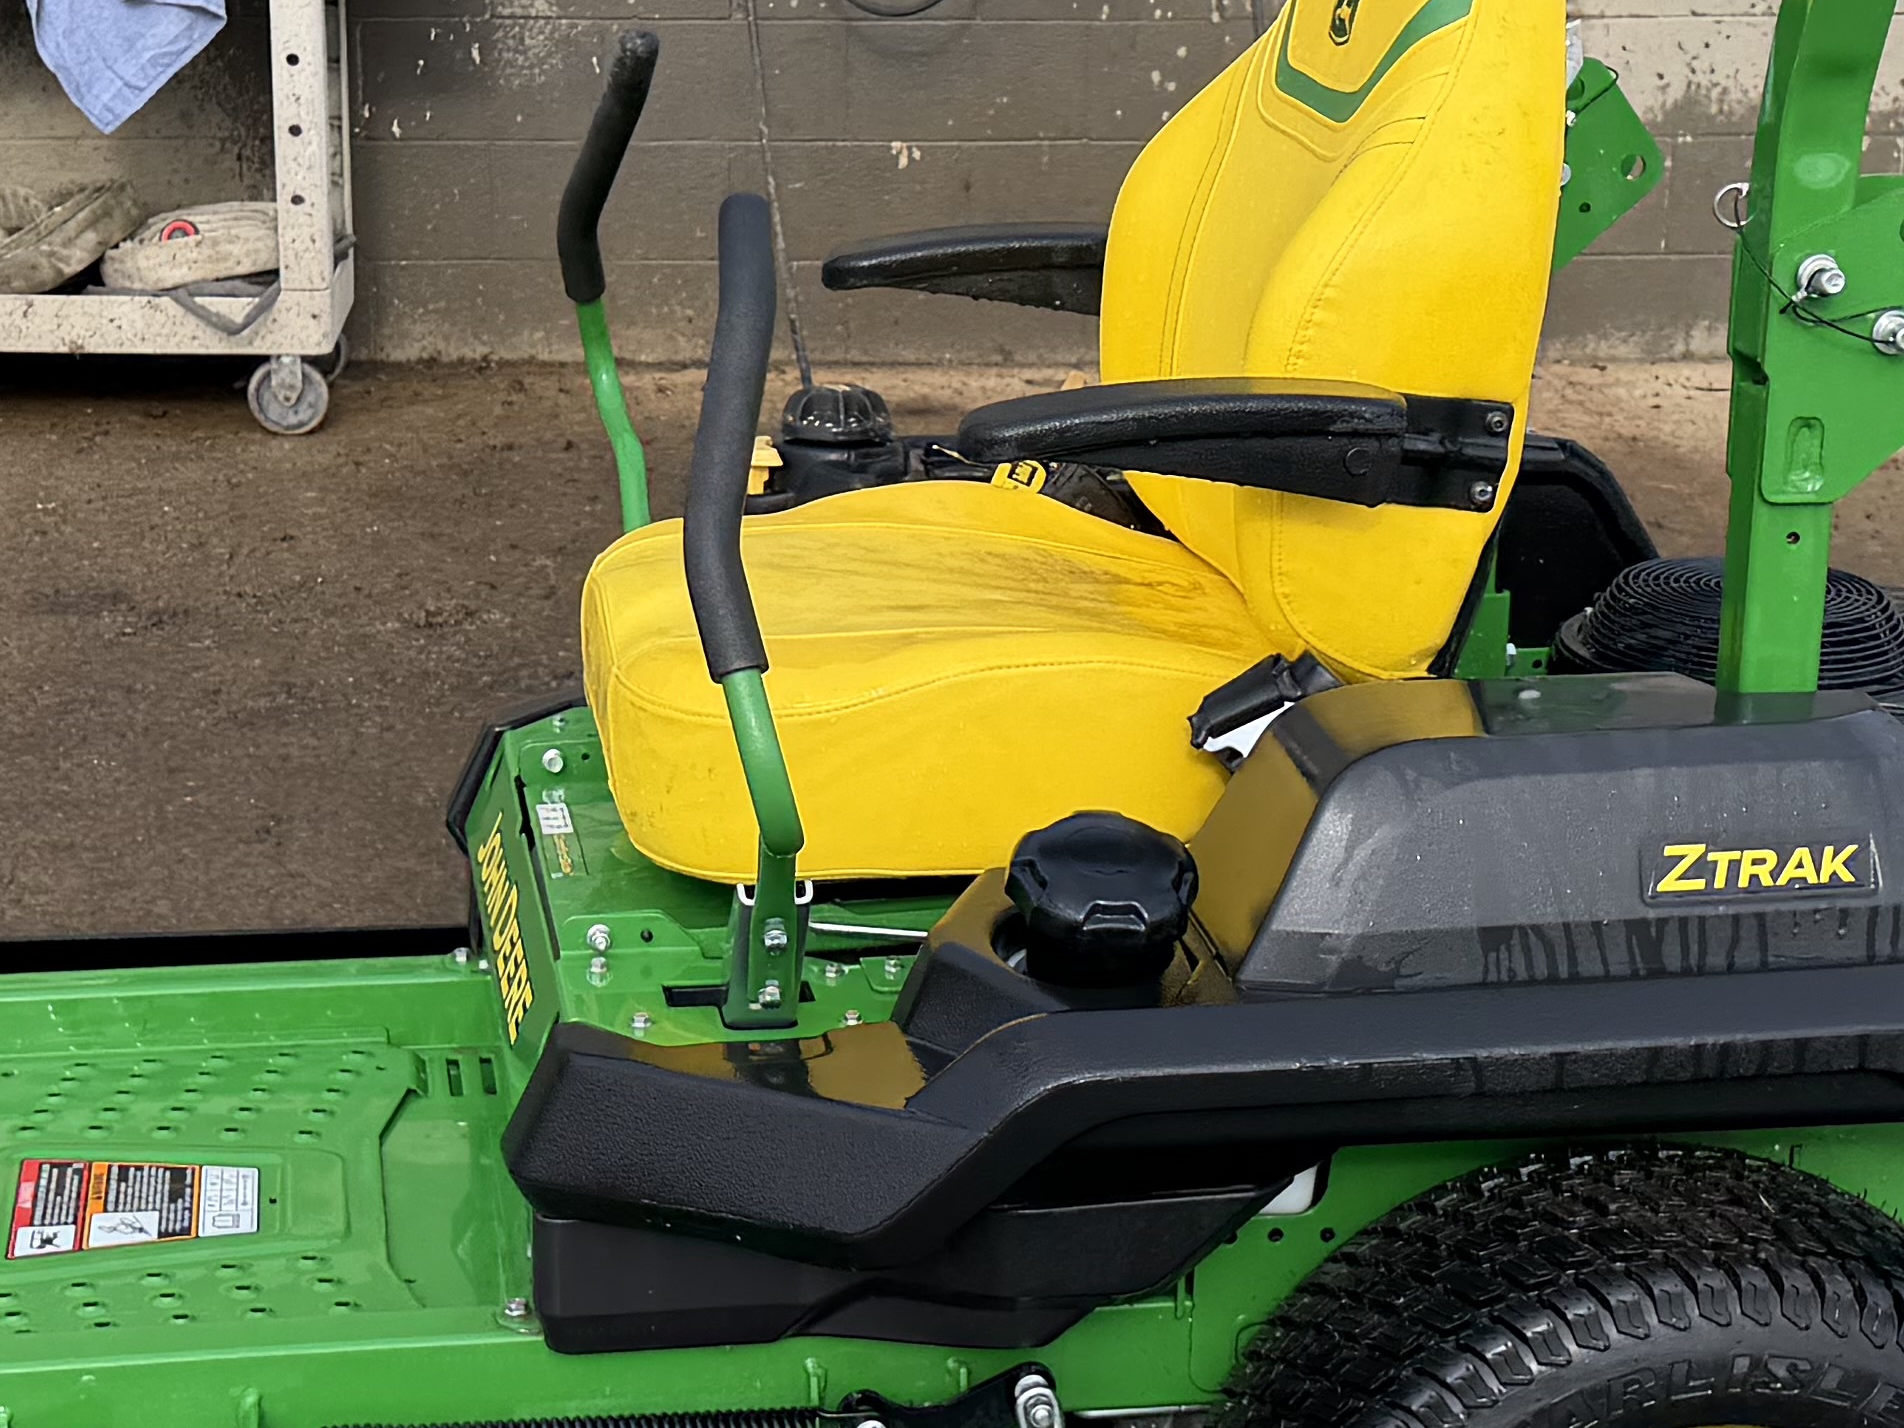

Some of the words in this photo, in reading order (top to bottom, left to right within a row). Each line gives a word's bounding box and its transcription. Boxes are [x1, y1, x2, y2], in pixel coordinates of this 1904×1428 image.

[477, 810, 511, 928] JOHN
[1656, 843, 1860, 893] ZTRAK
[492, 883, 534, 1045] DEERE
